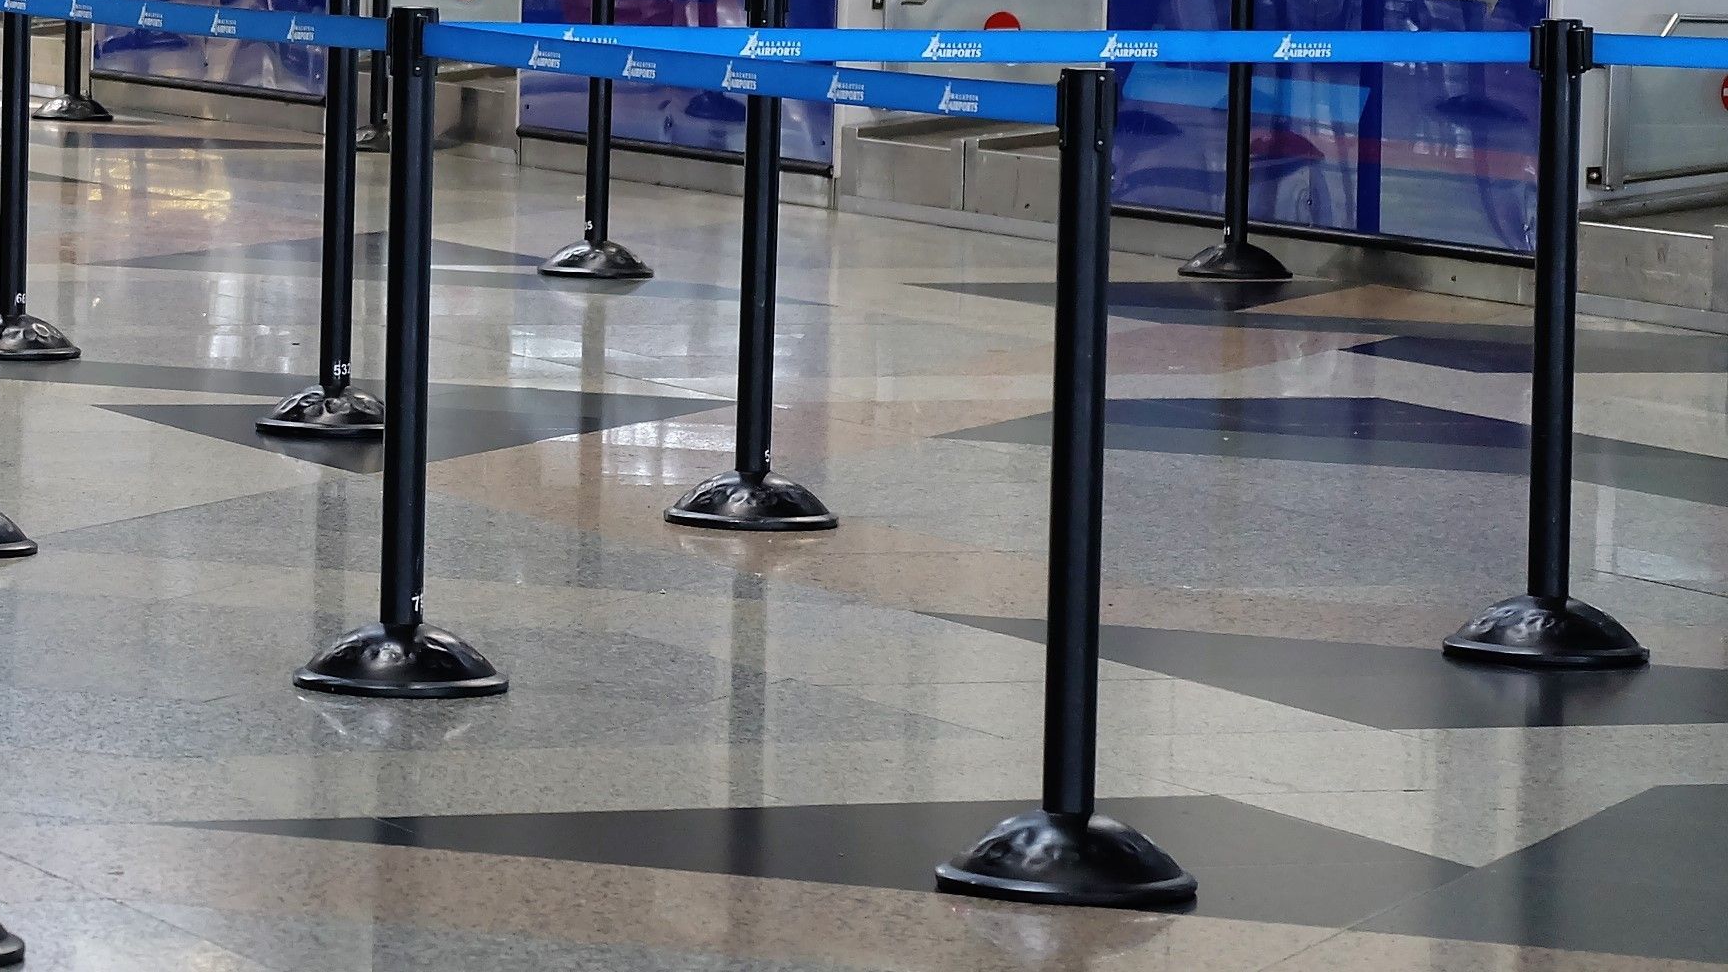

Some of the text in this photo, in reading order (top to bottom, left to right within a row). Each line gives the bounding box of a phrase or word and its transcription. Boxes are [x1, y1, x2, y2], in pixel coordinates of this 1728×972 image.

[758, 40, 802, 48] MALAYSIA
[941, 41, 983, 49] MALAYSIA
[1117, 41, 1159, 49] MALAYSIA
[1291, 41, 1332, 49] MALAYSIA
[756, 46, 802, 57] AIRPORTS
[937, 48, 983, 58] AIRPORTS
[1114, 48, 1159, 58] AIRPORTS
[1288, 48, 1332, 58] AIRPORTS
